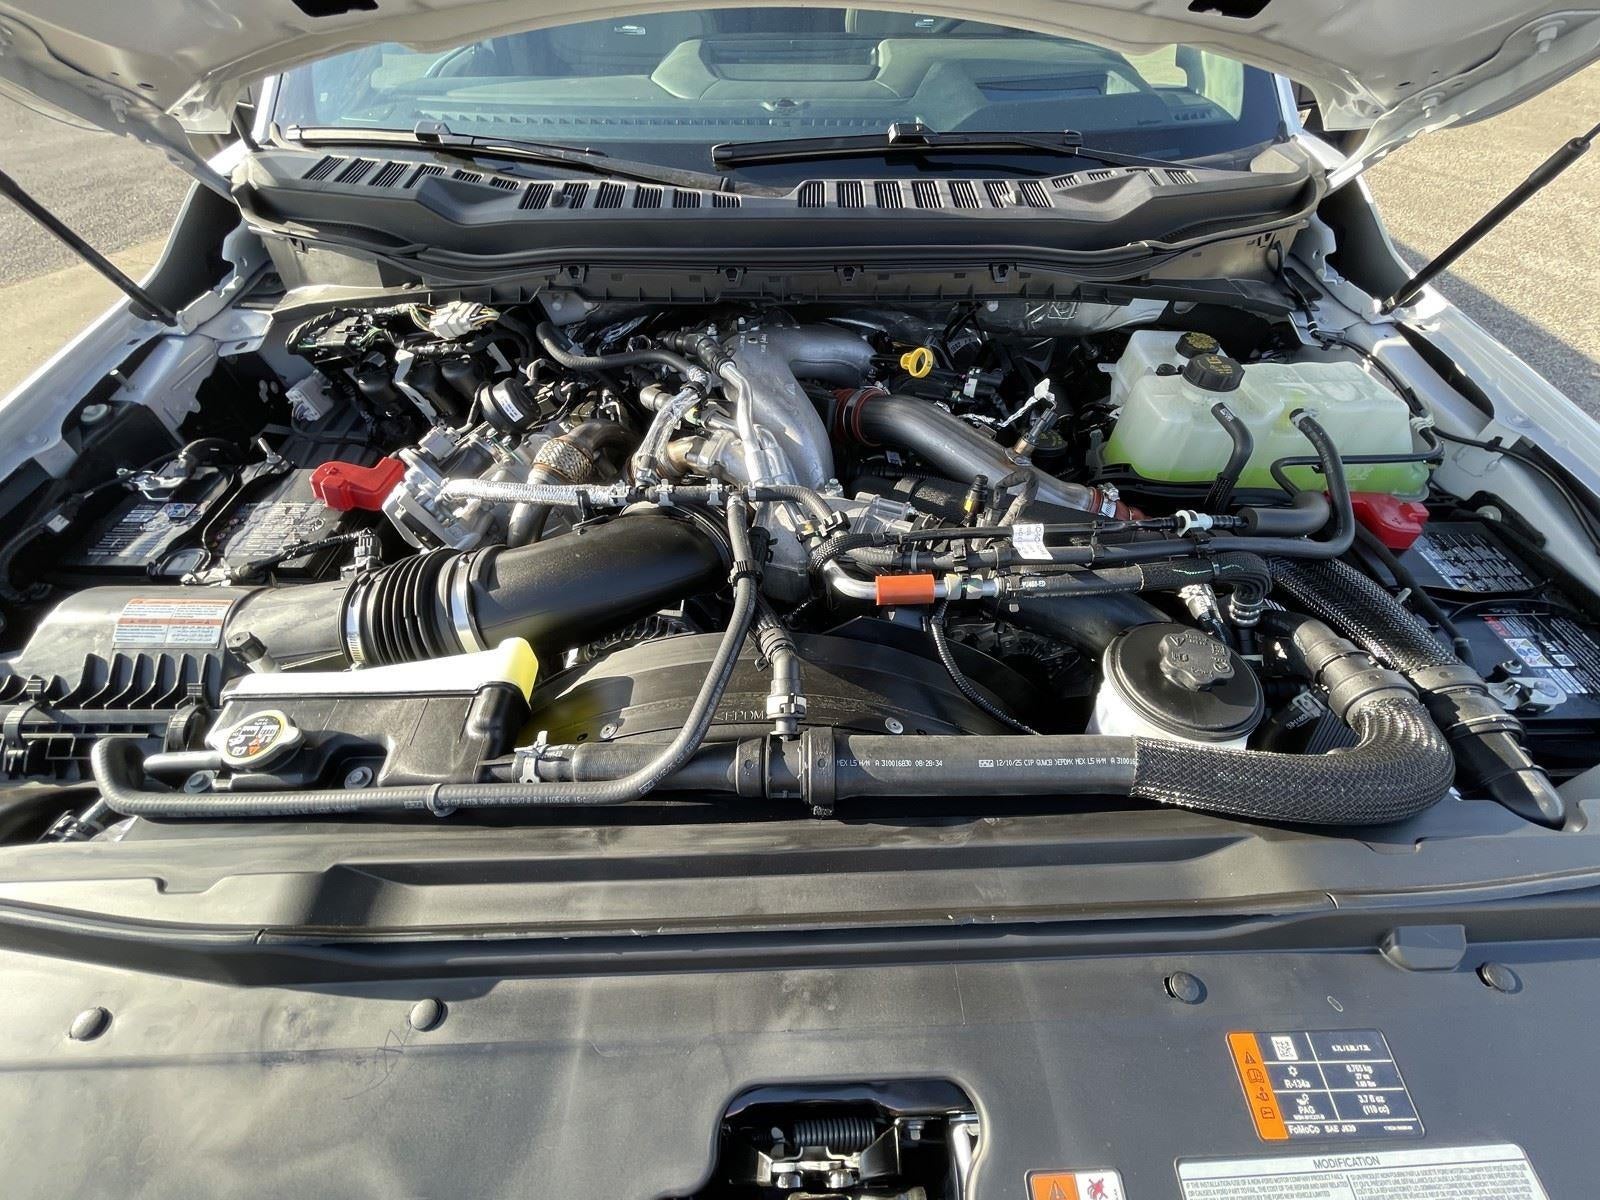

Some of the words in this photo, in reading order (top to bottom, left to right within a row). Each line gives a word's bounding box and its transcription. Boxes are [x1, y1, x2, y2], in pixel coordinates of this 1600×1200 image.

[1284, 1079, 1311, 1088] R-134a
[1298, 1105, 1315, 1114] PAG
[1288, 1124, 1320, 1134] FoMoCo
[1313, 1155, 1381, 1170] MODIFICATION
